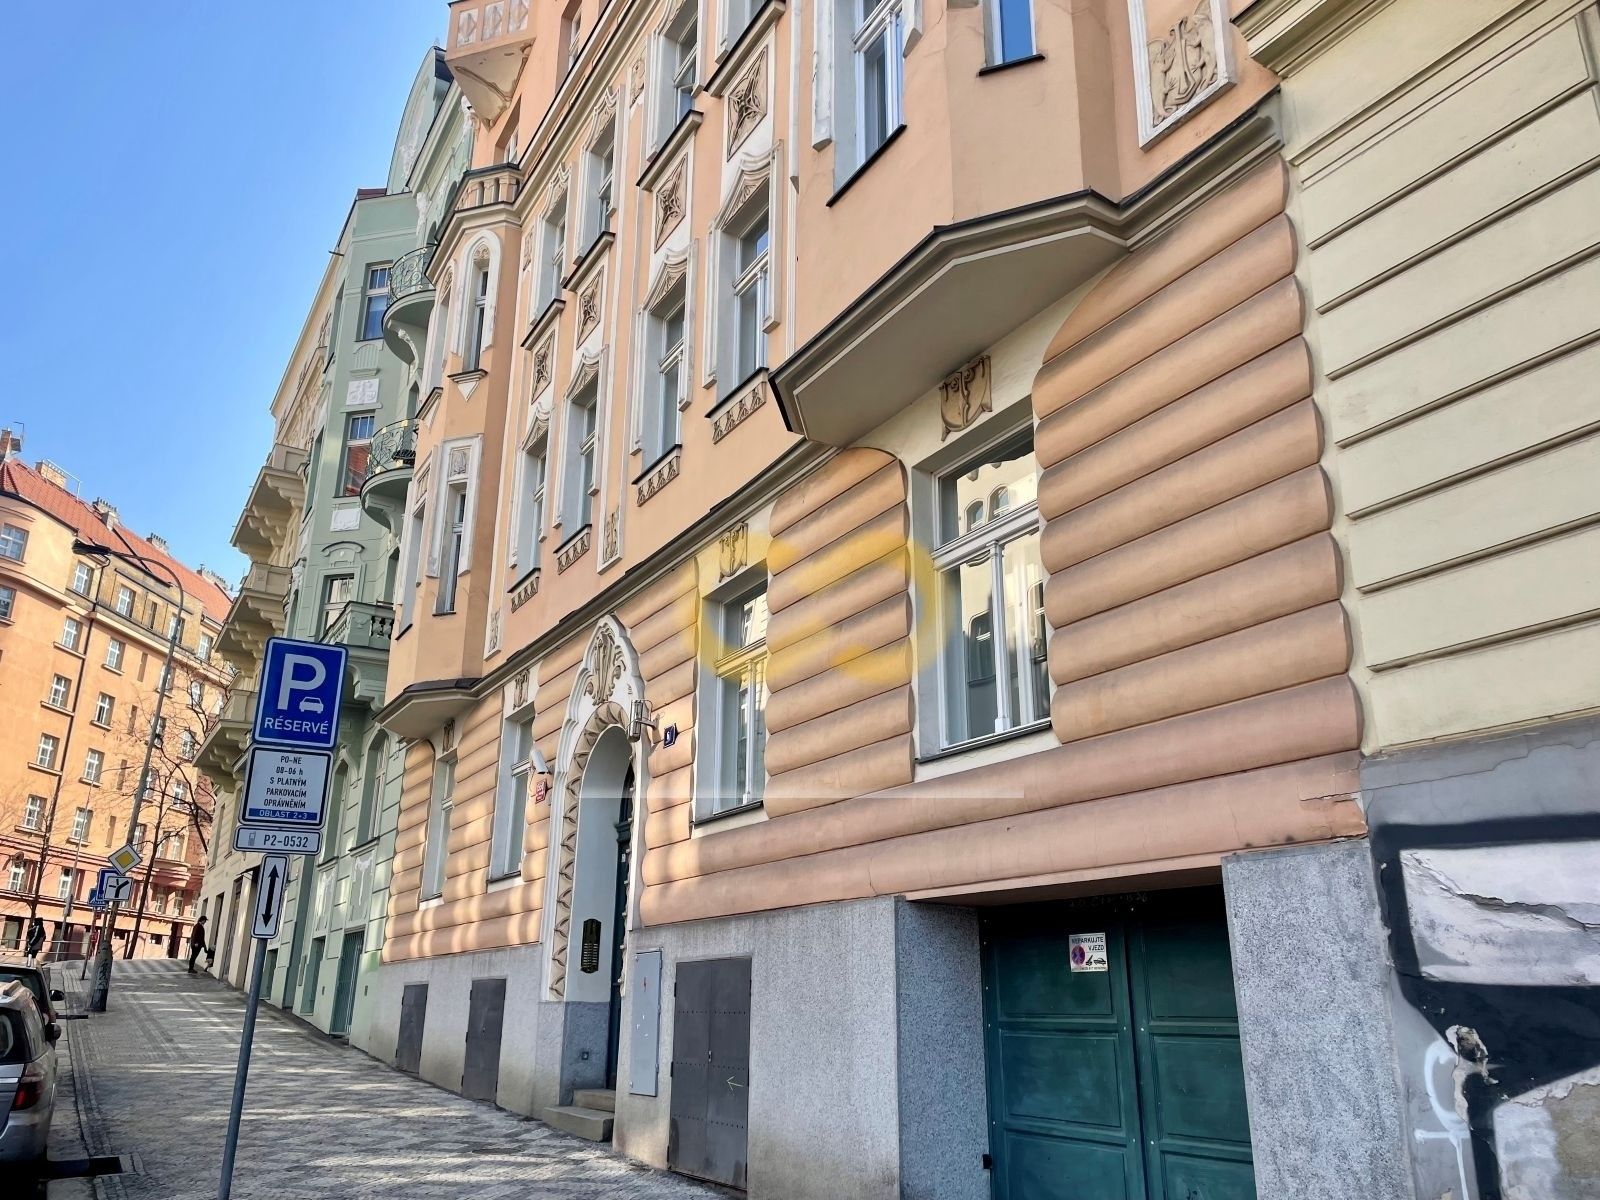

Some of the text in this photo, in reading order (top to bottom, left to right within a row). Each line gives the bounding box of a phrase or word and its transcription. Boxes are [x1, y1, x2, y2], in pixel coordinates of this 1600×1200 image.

[277, 653, 326, 710] P
[264, 716, 329, 735] RÉSERVÉ
[280, 755, 302, 764] PO-NE
[276, 766, 297, 775] 08-06
[269, 776, 307, 787] S PLATNÝM
[266, 787, 307, 798] PARKOVACÍM
[263, 797, 306, 809] OPRÁVNĚNÍM
[259, 809, 291, 818] OBLAST
[263, 834, 309, 848] P2-0532
